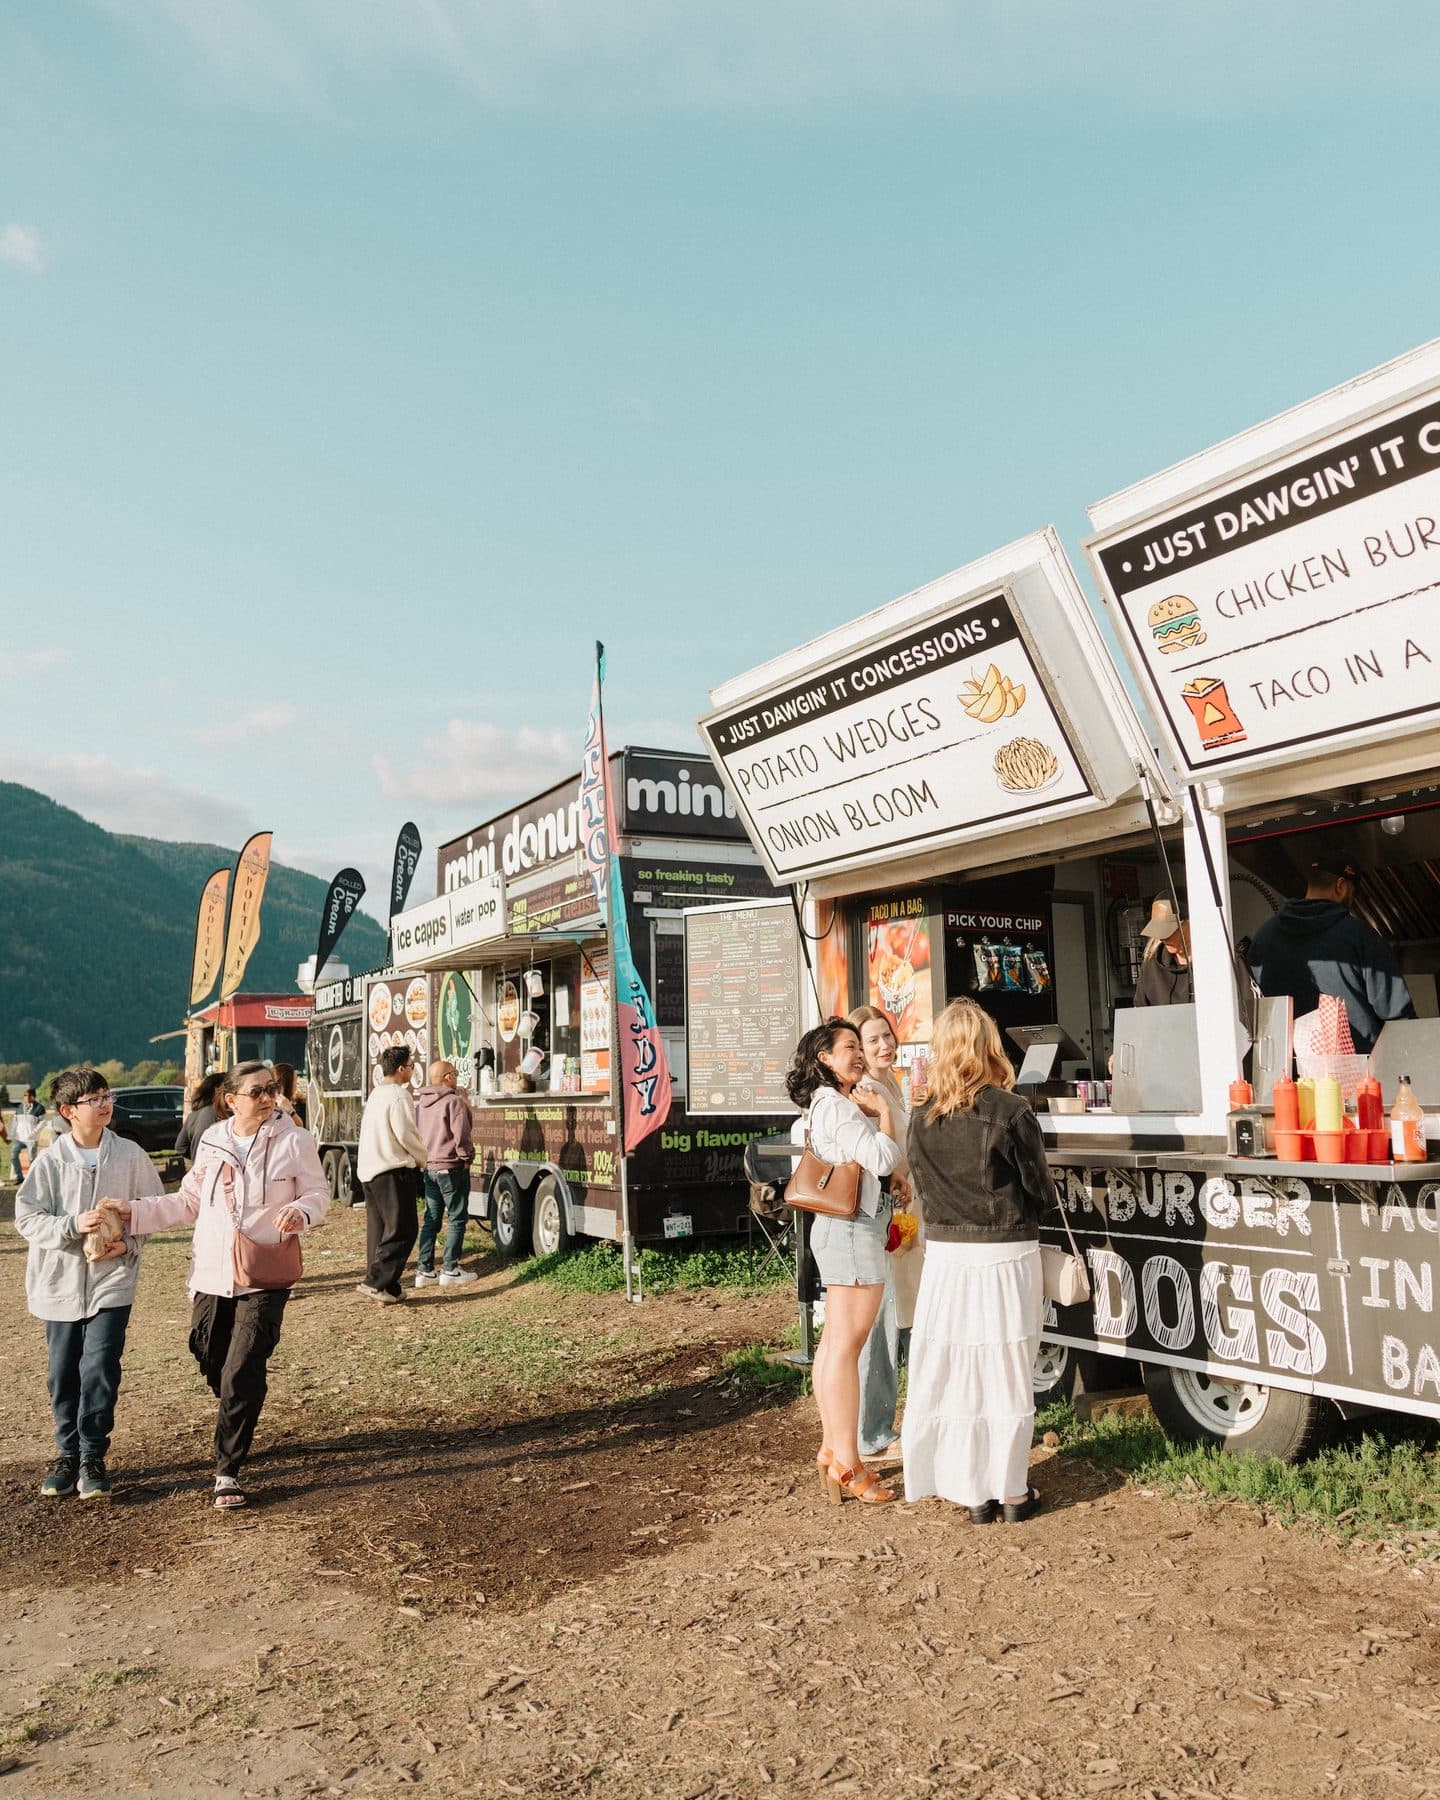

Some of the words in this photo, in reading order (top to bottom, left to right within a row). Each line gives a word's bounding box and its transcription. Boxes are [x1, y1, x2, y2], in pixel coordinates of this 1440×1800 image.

[1142, 522, 1207, 572] JUST
[1369, 436, 1405, 476] IT
[1215, 548, 1350, 619] CHICKEN
[729, 717, 760, 744] JUST
[831, 679, 848, 702] IT
[850, 618, 988, 692] CONCESSIONS
[1250, 666, 1331, 710] TACO
[1345, 649, 1383, 685] IN
[1405, 638, 1432, 669] A
[737, 744, 819, 796] POTATO
[824, 697, 942, 764] WEDGES
[768, 809, 841, 853] ONION
[843, 779, 939, 832] BLOOM
[395, 844, 408, 902] Cream
[407, 848, 418, 876] Ice
[445, 825, 495, 894] mini
[638, 870, 652, 880] so
[655, 868, 703, 884] freaking
[706, 872, 736, 886] tasty
[327, 886, 345, 935] Cream
[344, 890, 358, 913] Ice
[396, 926, 411, 951] ice
[414, 915, 447, 947] capps
[455, 907, 474, 928] water
[478, 899, 496, 921] pop
[719, 912, 733, 921] THE
[736, 909, 758, 920] MENU
[871, 904, 889, 921] TACO
[890, 902, 899, 918] IN
[900, 901, 905, 915] A
[906, 897, 923, 915] BAG
[948, 914, 976, 927] PICK
[979, 915, 1012, 929] YOUR
[1015, 918, 1042, 931] CHIP
[661, 1131, 691, 1152] big
[1104, 1168, 1312, 1237] BURGER
[1086, 1249, 1328, 1375] DOGS
[1359, 1256, 1433, 1312] IN
